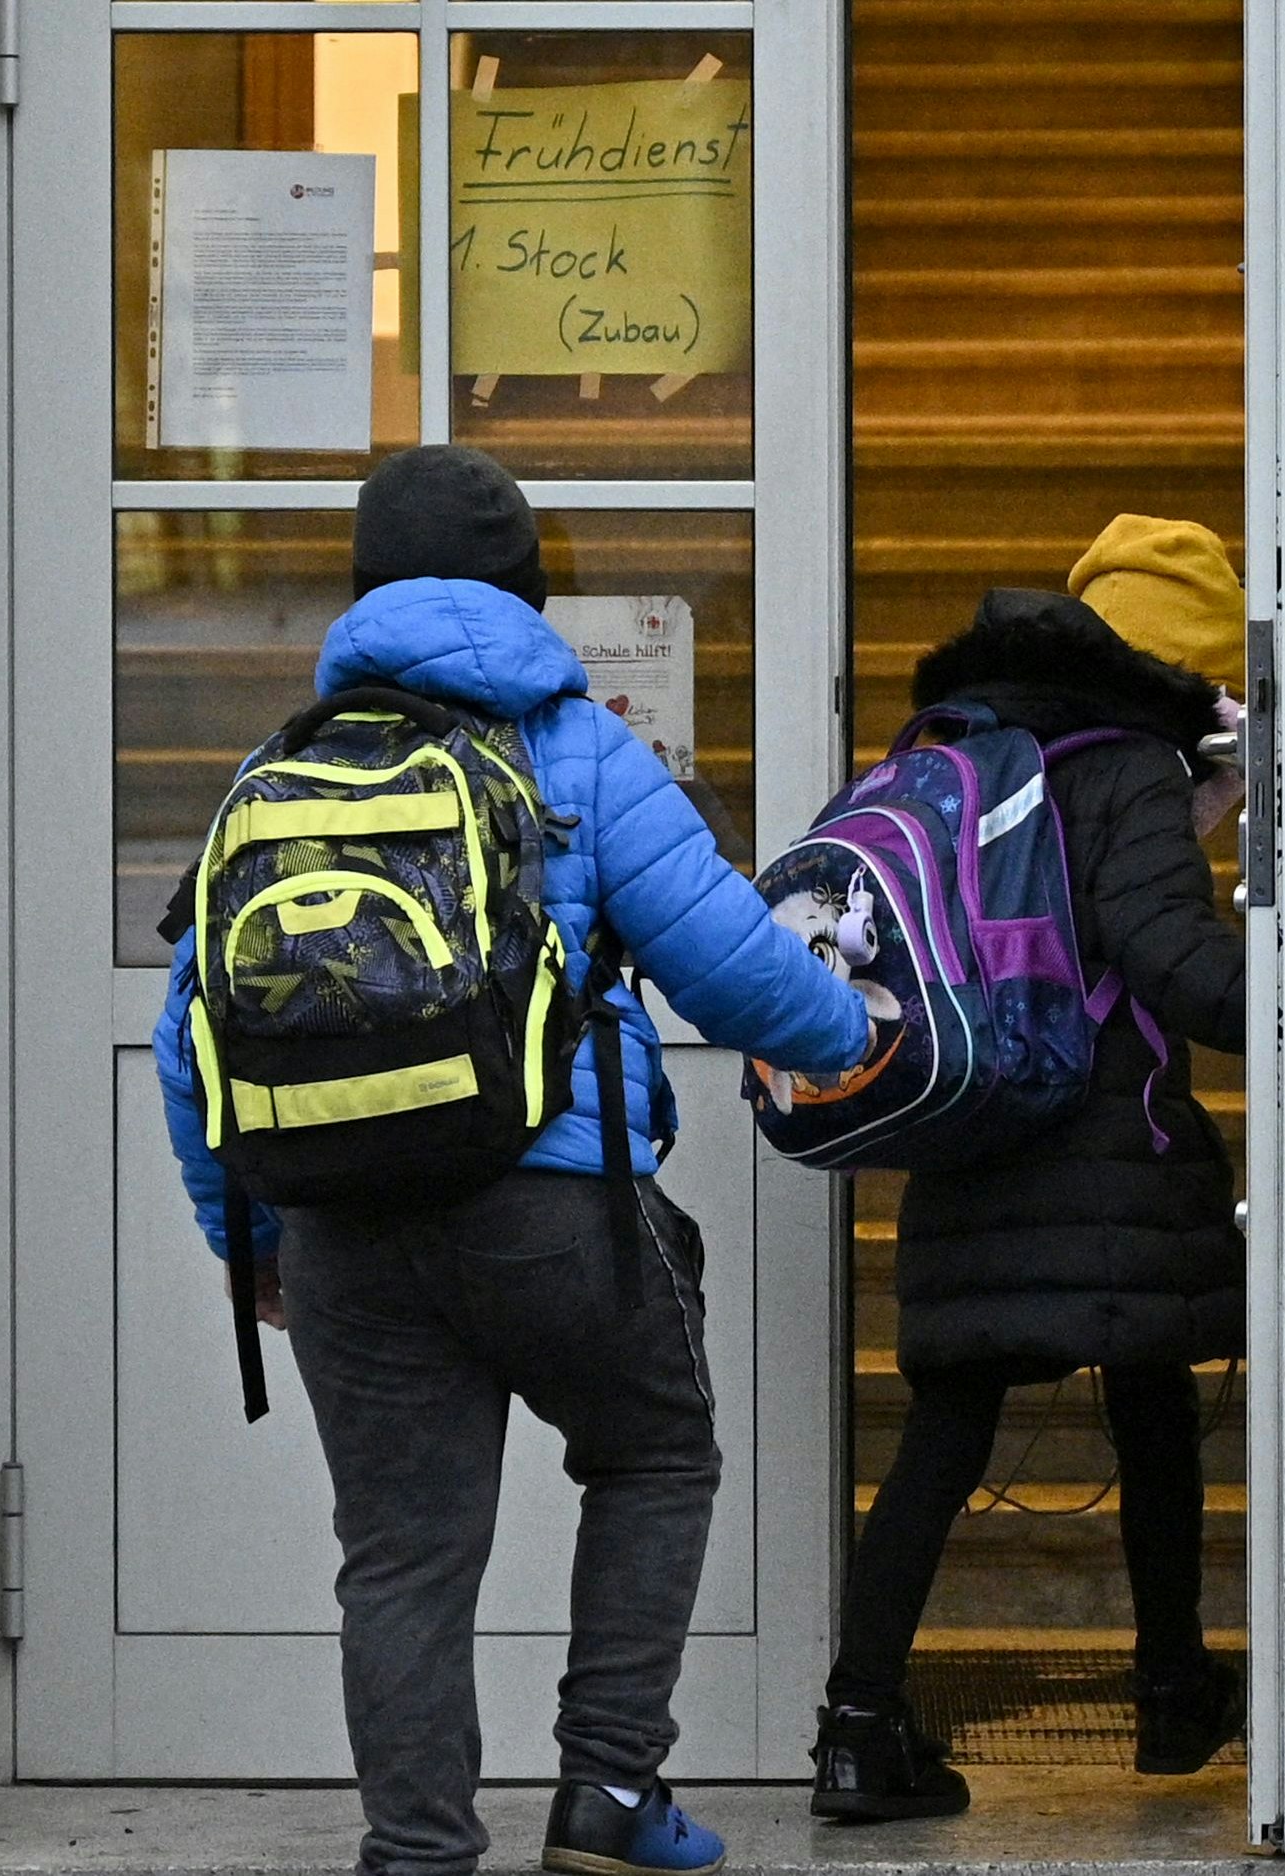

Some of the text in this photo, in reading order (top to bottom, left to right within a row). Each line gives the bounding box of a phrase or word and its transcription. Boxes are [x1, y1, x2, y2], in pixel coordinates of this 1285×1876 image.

[476, 104, 748, 172] Frühdienst
[450, 224, 628, 280] 1. Stock
[558, 294, 700, 354] (Zubau)
[582, 644, 630, 658] Schule
[635, 644, 672, 658] hilft!
